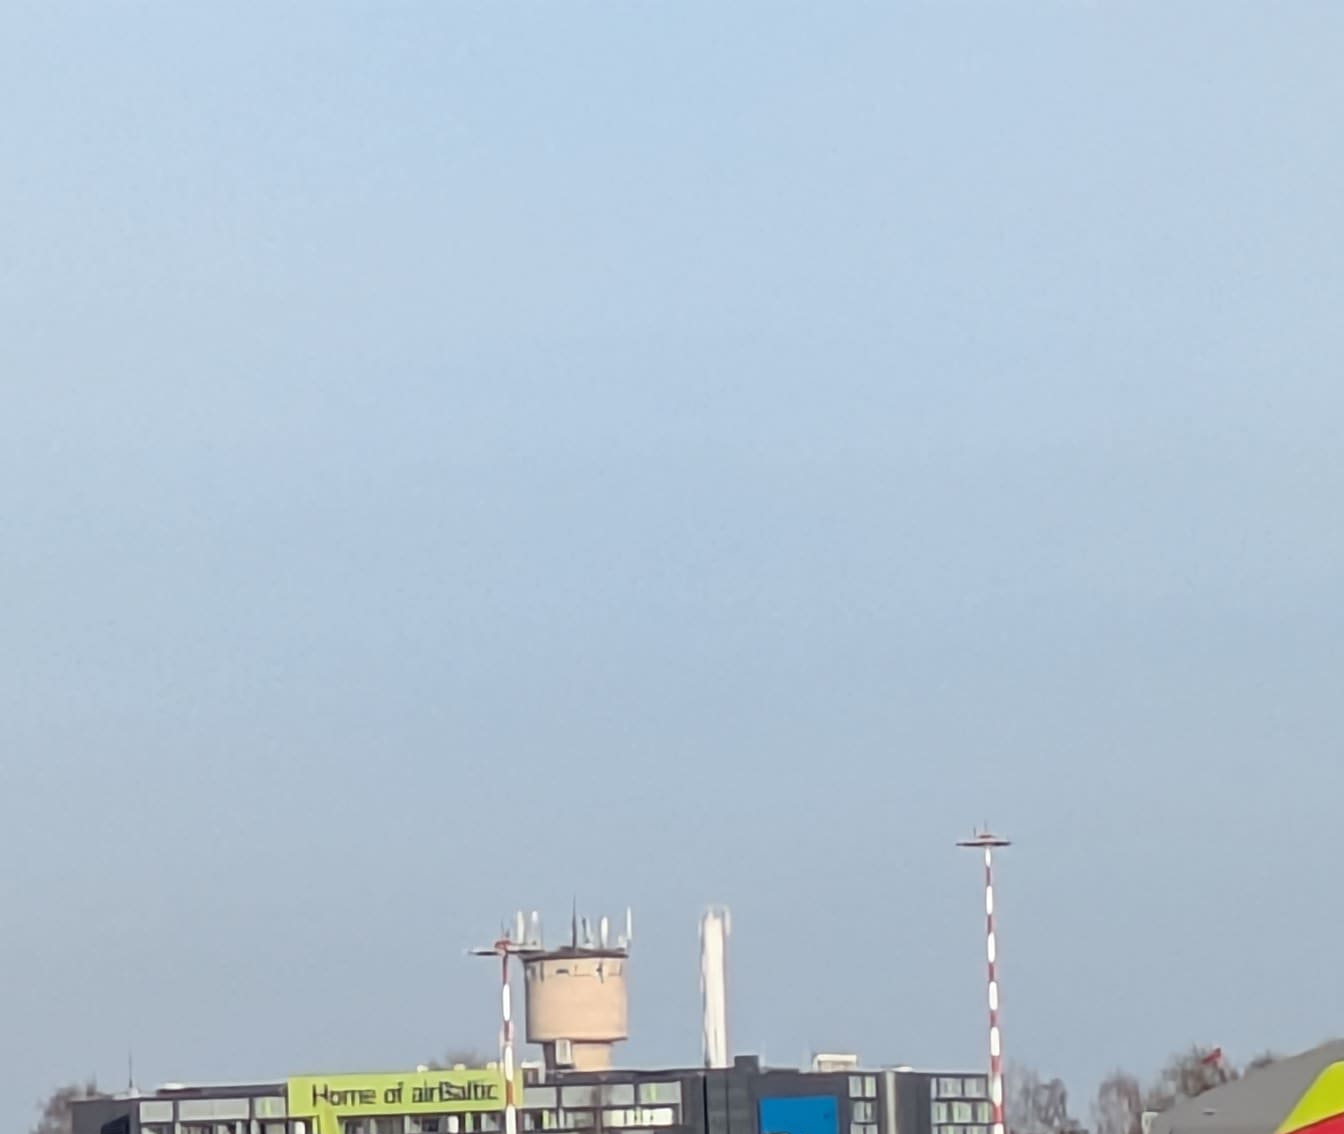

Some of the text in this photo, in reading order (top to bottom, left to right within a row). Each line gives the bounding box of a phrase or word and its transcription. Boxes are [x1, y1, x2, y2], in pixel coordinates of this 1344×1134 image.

[312, 1078, 499, 1107] Home of airBaltic
